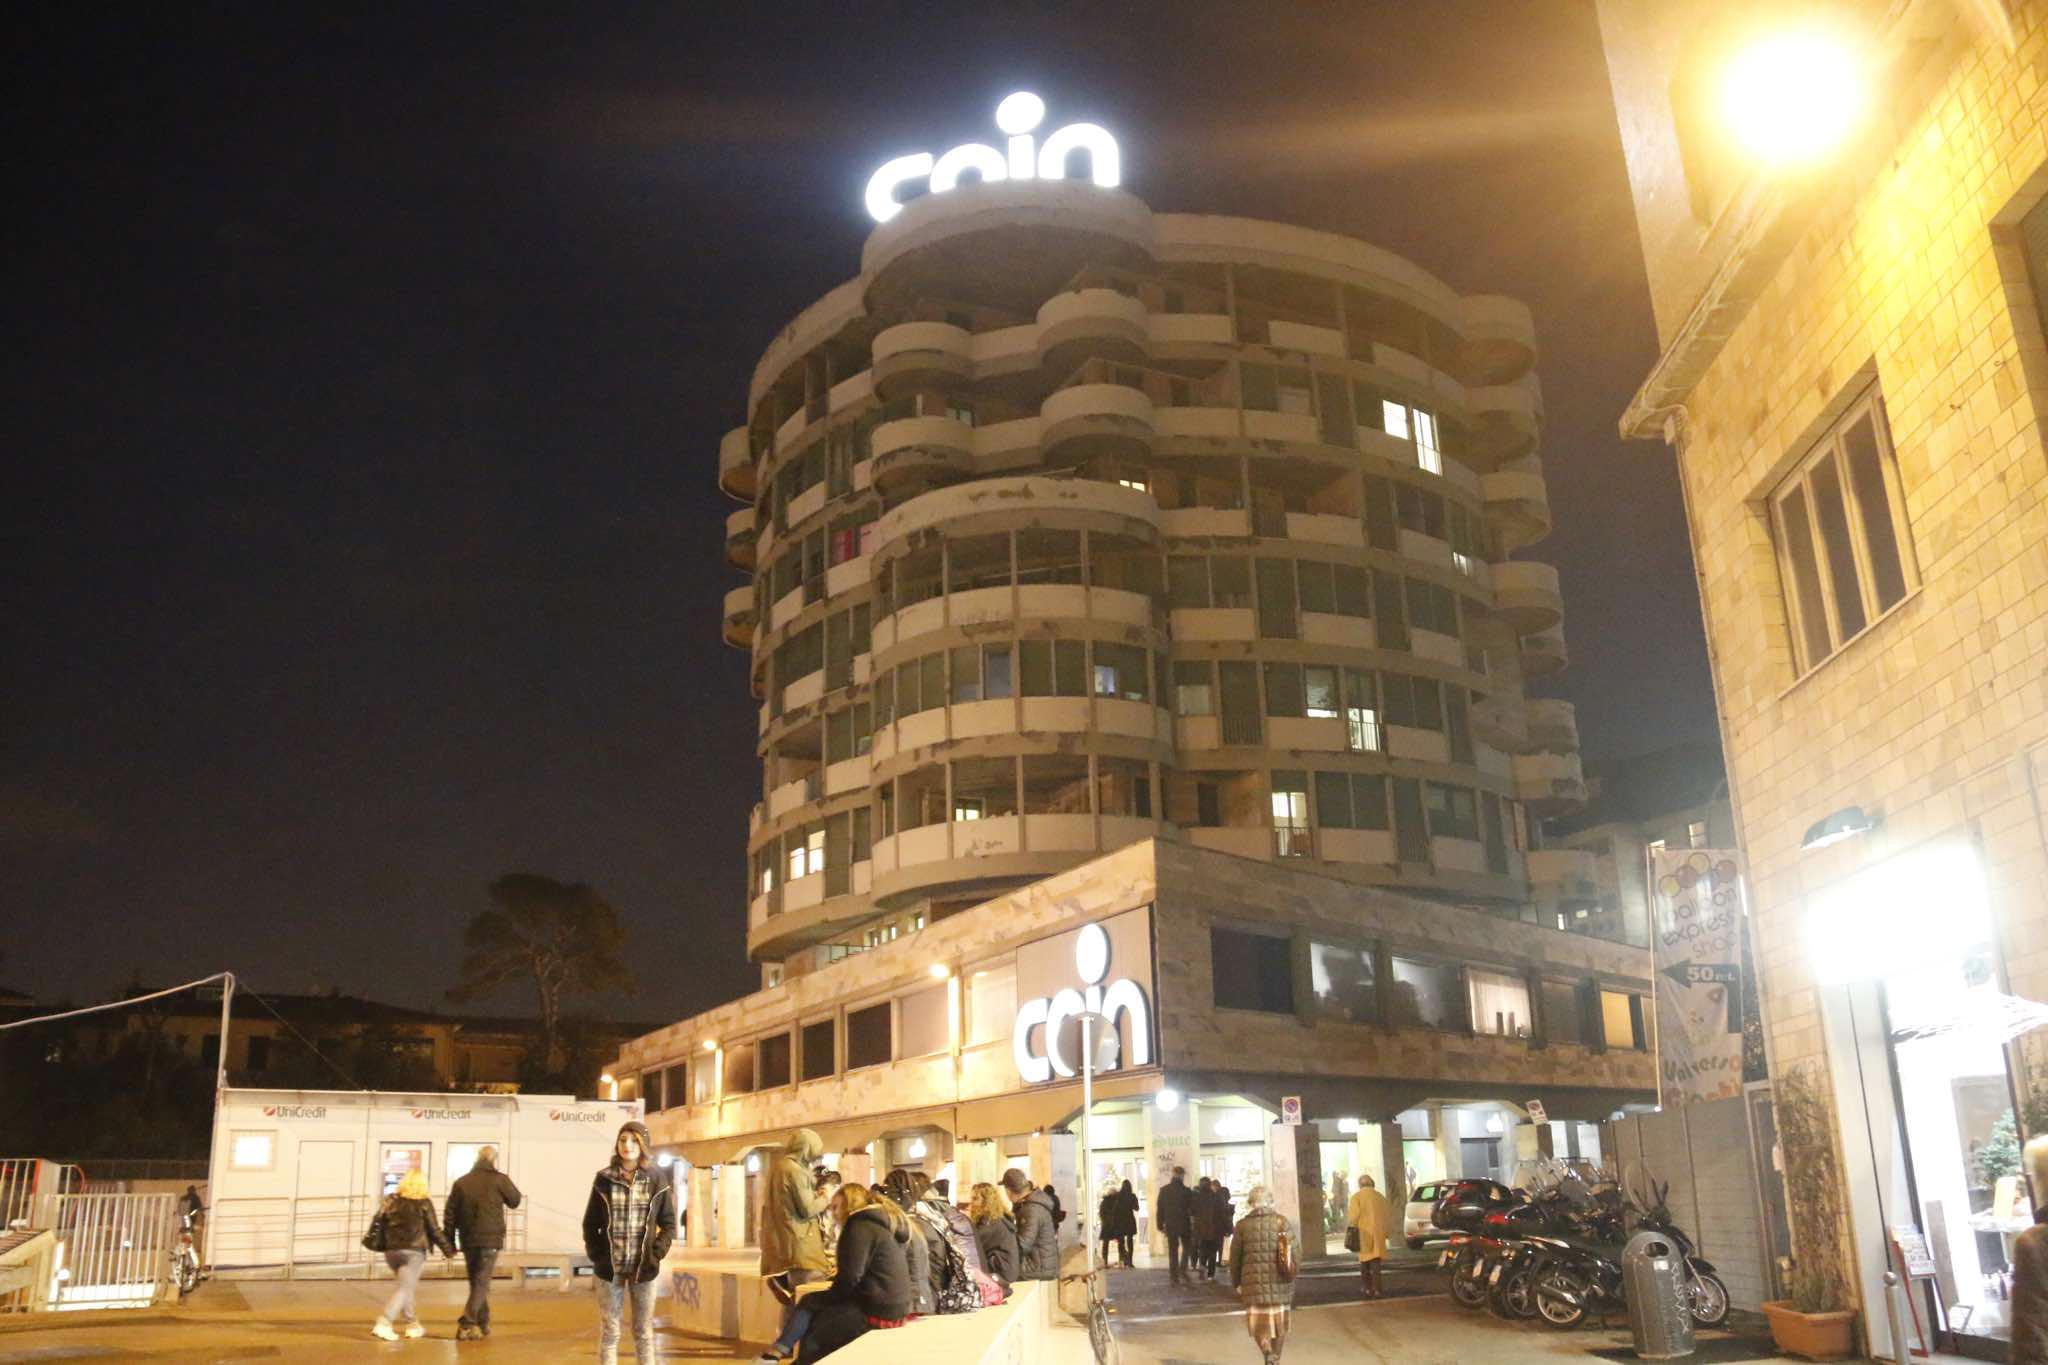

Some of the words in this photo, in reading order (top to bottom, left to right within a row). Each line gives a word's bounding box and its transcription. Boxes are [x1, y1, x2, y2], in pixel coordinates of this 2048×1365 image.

[1662, 911, 1735, 946] express
[277, 1106, 326, 1118] UniCredit
[424, 1108, 471, 1120] UniCredit
[561, 1111, 606, 1122] UniCredit
